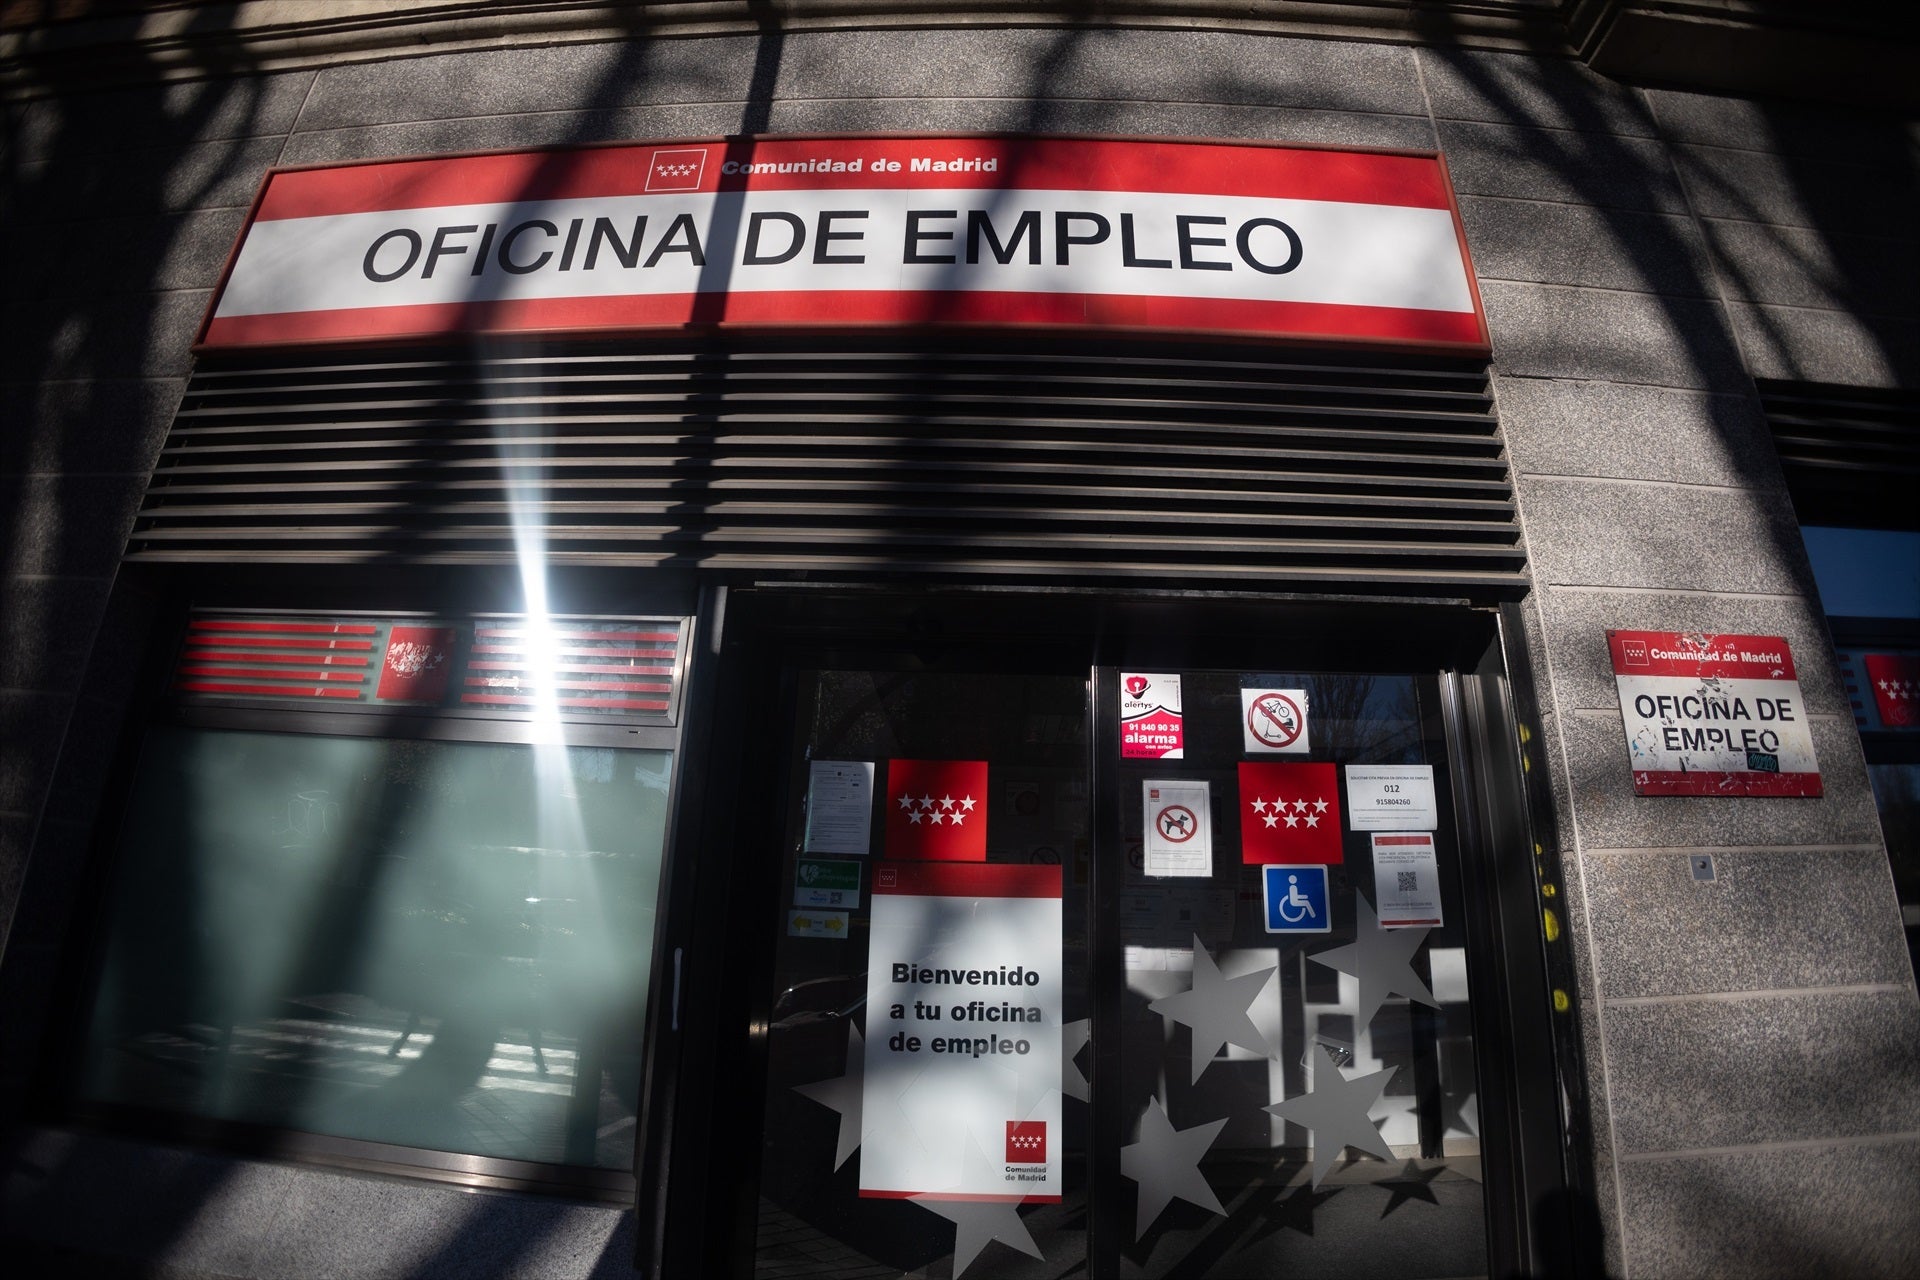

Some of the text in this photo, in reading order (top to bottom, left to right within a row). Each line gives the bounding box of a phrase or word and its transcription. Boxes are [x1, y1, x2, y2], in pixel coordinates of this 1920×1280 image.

[721, 158, 998, 175] Comunidad de Madrid
[362, 210, 1304, 283] OFICINA DE EMPLEO
[1651, 648, 1783, 664] Comunidad de Madrid
[1124, 701, 1153, 709] alertys
[1634, 694, 1795, 721] OFICINA DE
[1128, 723, 1138, 731] 91
[1141, 723, 1156, 731] 840
[1169, 724, 1180, 732] 35
[1124, 732, 1178, 744] alarma
[1662, 727, 1780, 753] EMPLEO
[1384, 785, 1400, 793] 012
[892, 963, 1040, 986] Bienvenido
[890, 1001, 1042, 1023] a tu oficina
[889, 1032, 1031, 1058] de empleo
[1005, 1166, 1047, 1174] Comunidad
[1005, 1174, 1047, 1182] de Madrid
